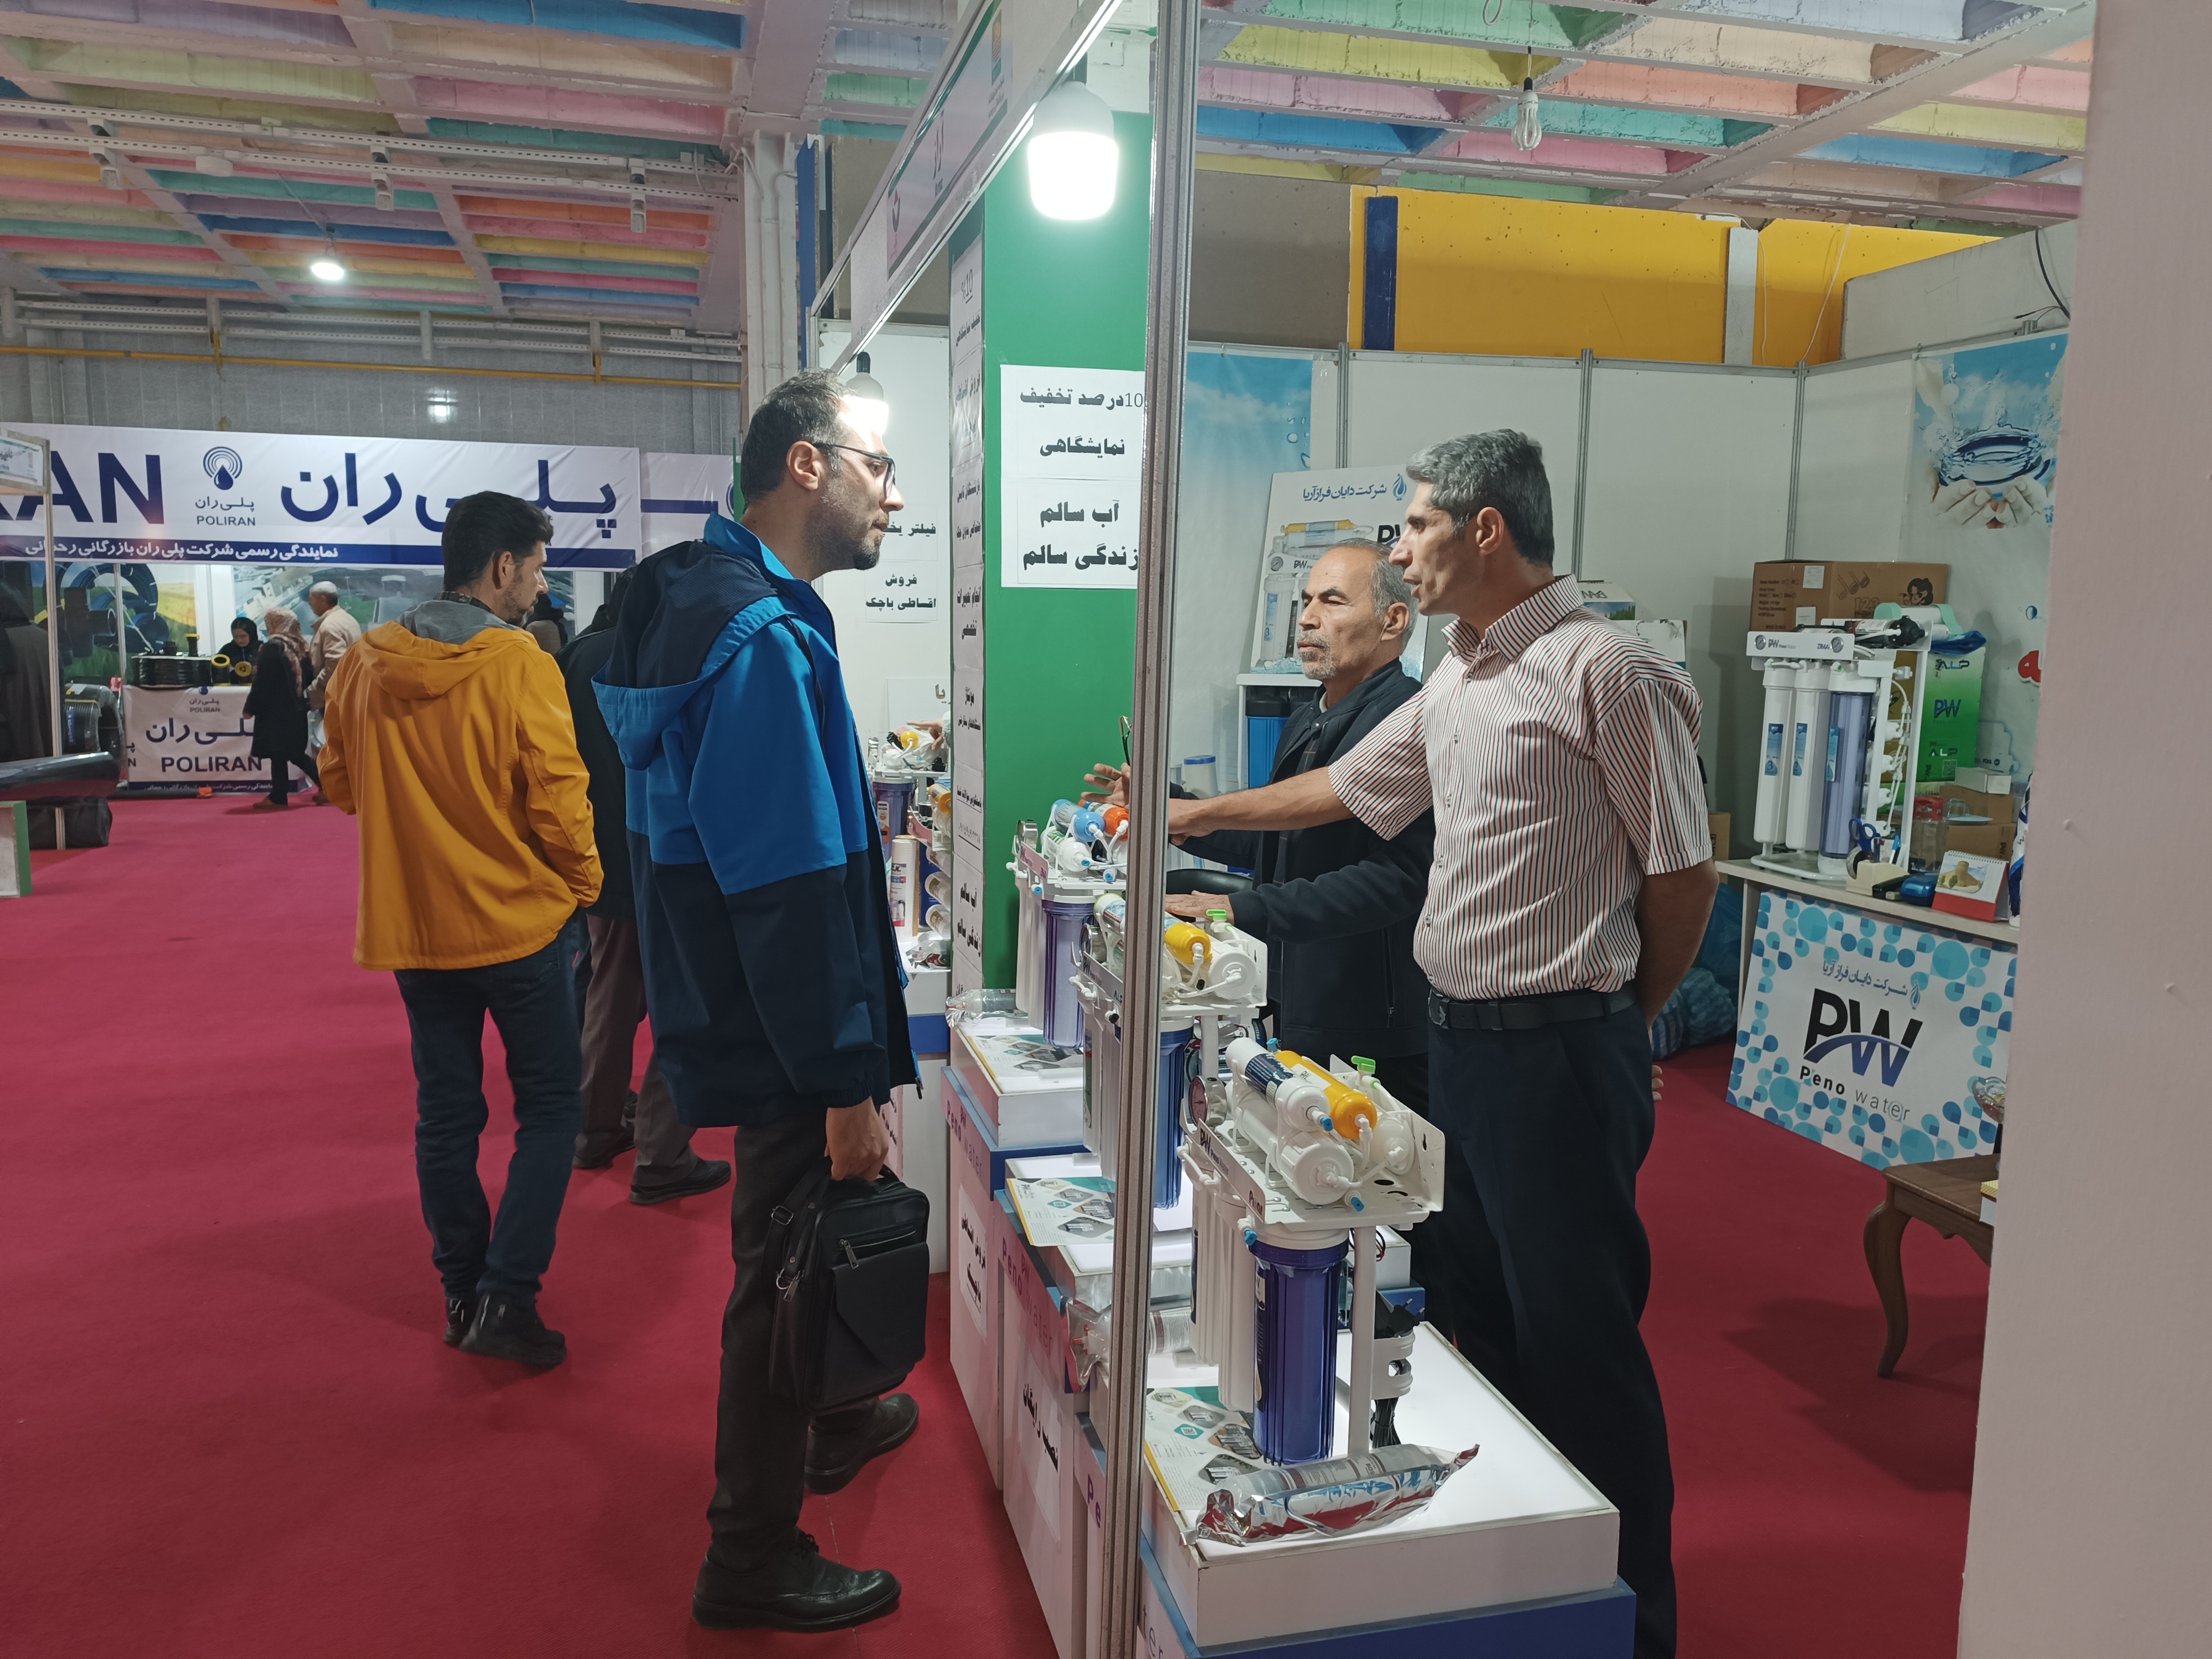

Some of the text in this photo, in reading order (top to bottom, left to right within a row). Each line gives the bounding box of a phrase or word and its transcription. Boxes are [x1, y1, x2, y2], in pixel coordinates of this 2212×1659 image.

[1020, 387, 1073, 408] تخفیف
[1040, 435, 1125, 458] نمایشگاهی
[280, 452, 403, 526] ران
[1331, 486, 1355, 499] دایان
[1355, 484, 1387, 499] شرکت
[195, 497, 255, 512] پلی ران
[196, 515, 256, 526] POLIRAN
[1040, 499, 1120, 528] آب سالم
[907, 523, 936, 537] فیلتر
[78, 540, 134, 556] بازرگانی
[186, 543, 234, 559] شرکت
[235, 547, 278, 560] رسمی
[279, 544, 338, 560] نمایندگی
[1023, 543, 1139, 571] زندگی سالم
[885, 573, 917, 587] فروش
[898, 598, 937, 611] اقساطی
[1264, 628, 1270, 636] 3
[145, 718, 254, 745] لی ران
[161, 756, 262, 773] POLIRAN
[1766, 760, 1773, 771] 3
[1848, 969, 1872, 987] دایان
[1874, 978, 1908, 997] شرکت
[1803, 988, 1923, 1088] PW
[1799, 1065, 1911, 1121] Peno water
[947, 1099, 962, 1143] Peno
[1001, 1236, 1023, 1296] Peno
